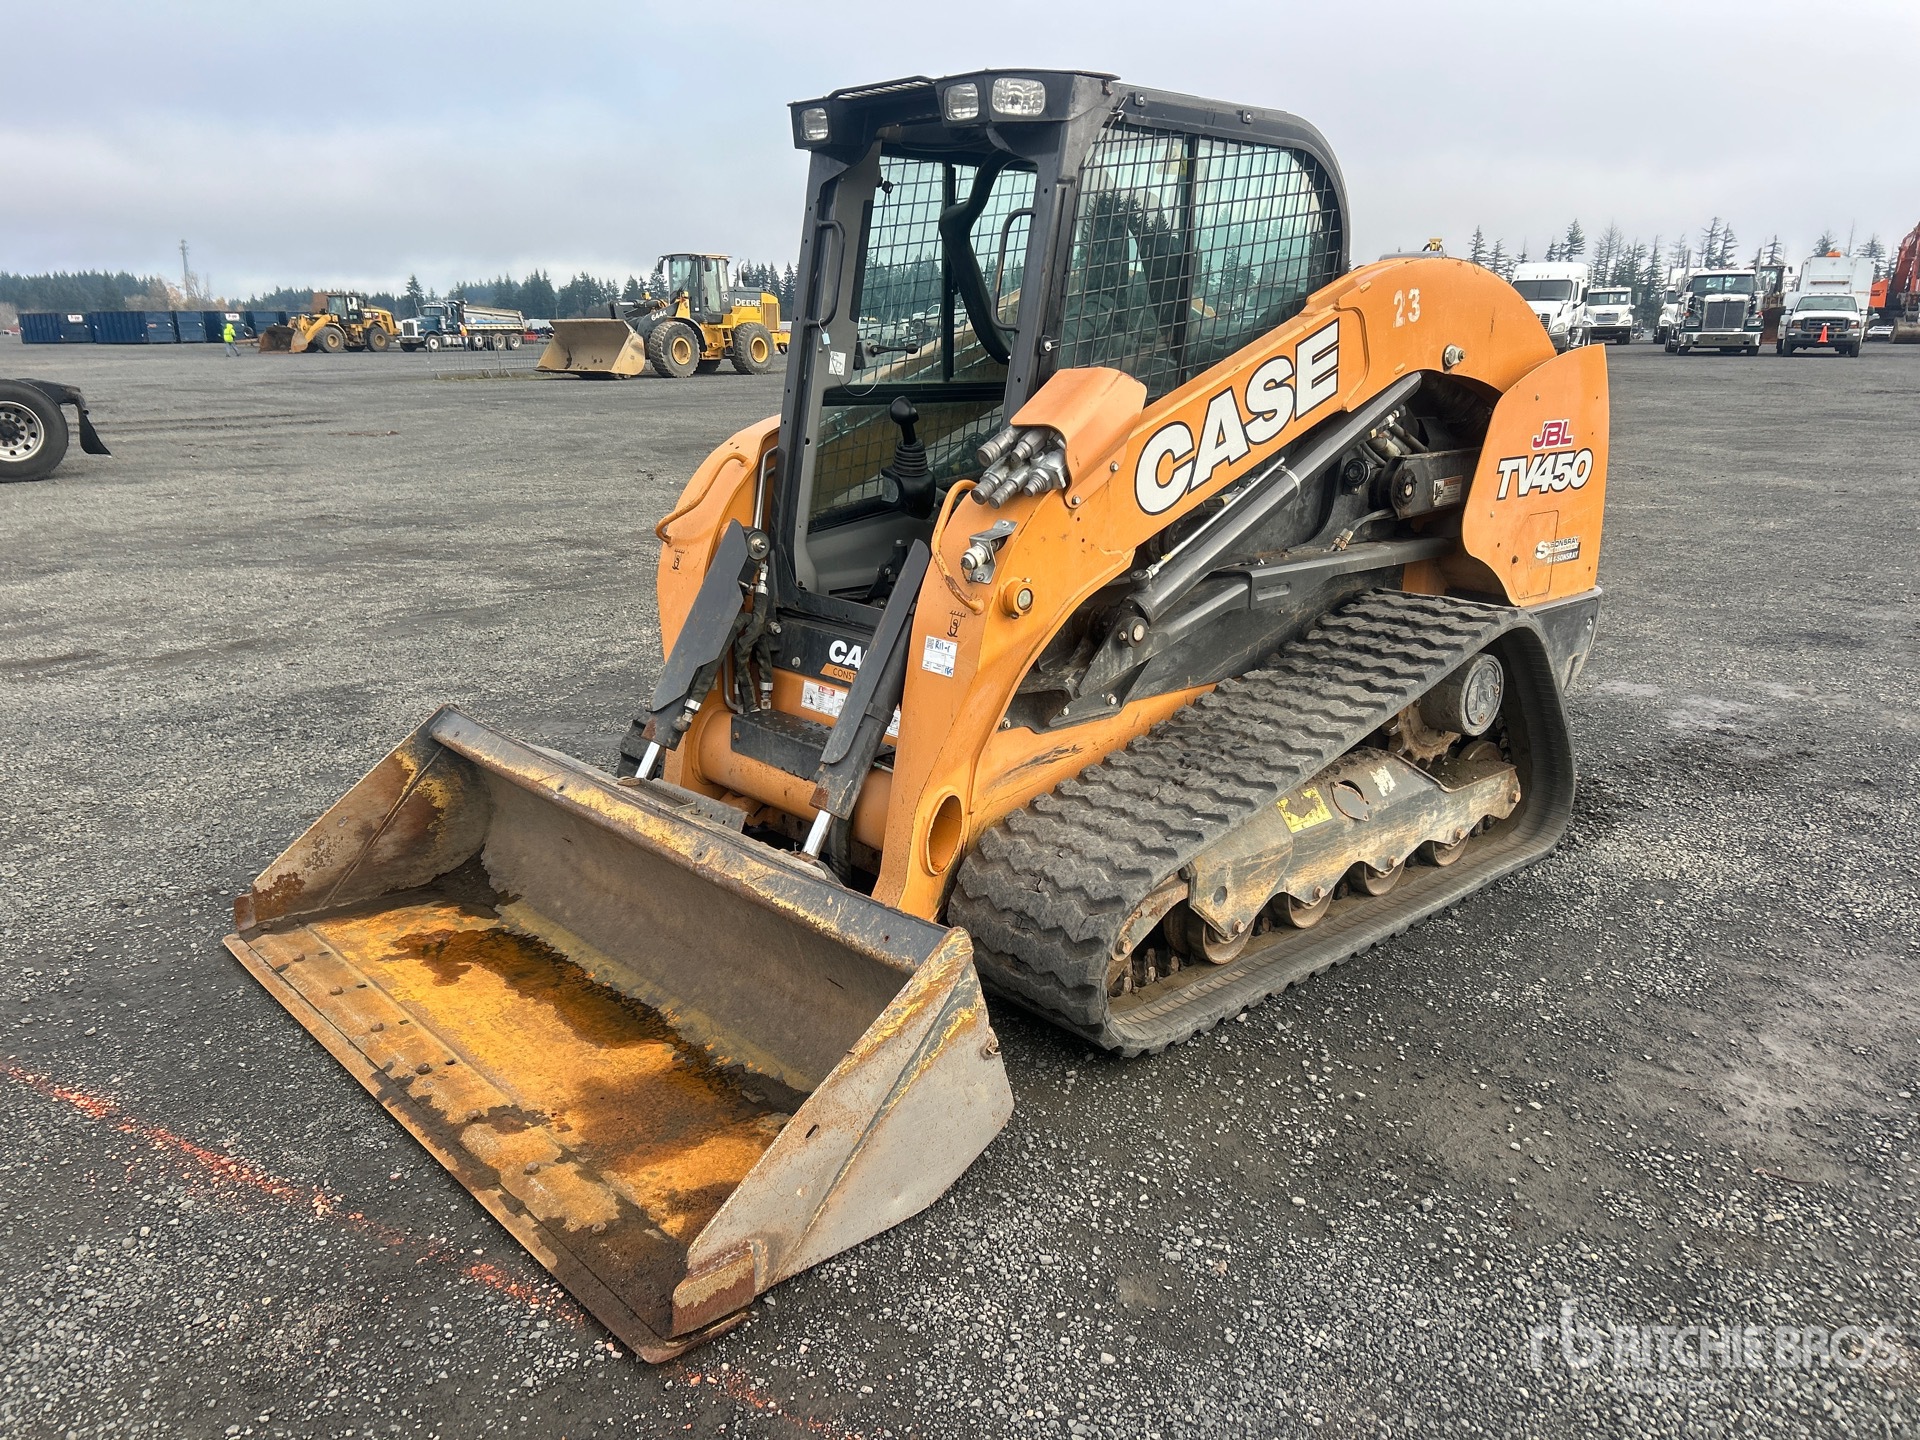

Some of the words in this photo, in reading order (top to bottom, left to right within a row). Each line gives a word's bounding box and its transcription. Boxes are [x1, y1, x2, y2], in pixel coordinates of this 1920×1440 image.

[735, 298, 761, 307] DEERE
[1393, 288, 1420, 328] 23
[1134, 317, 1340, 516] CASE
[1532, 419, 1574, 451] JBL
[1496, 448, 1593, 501] TV450
